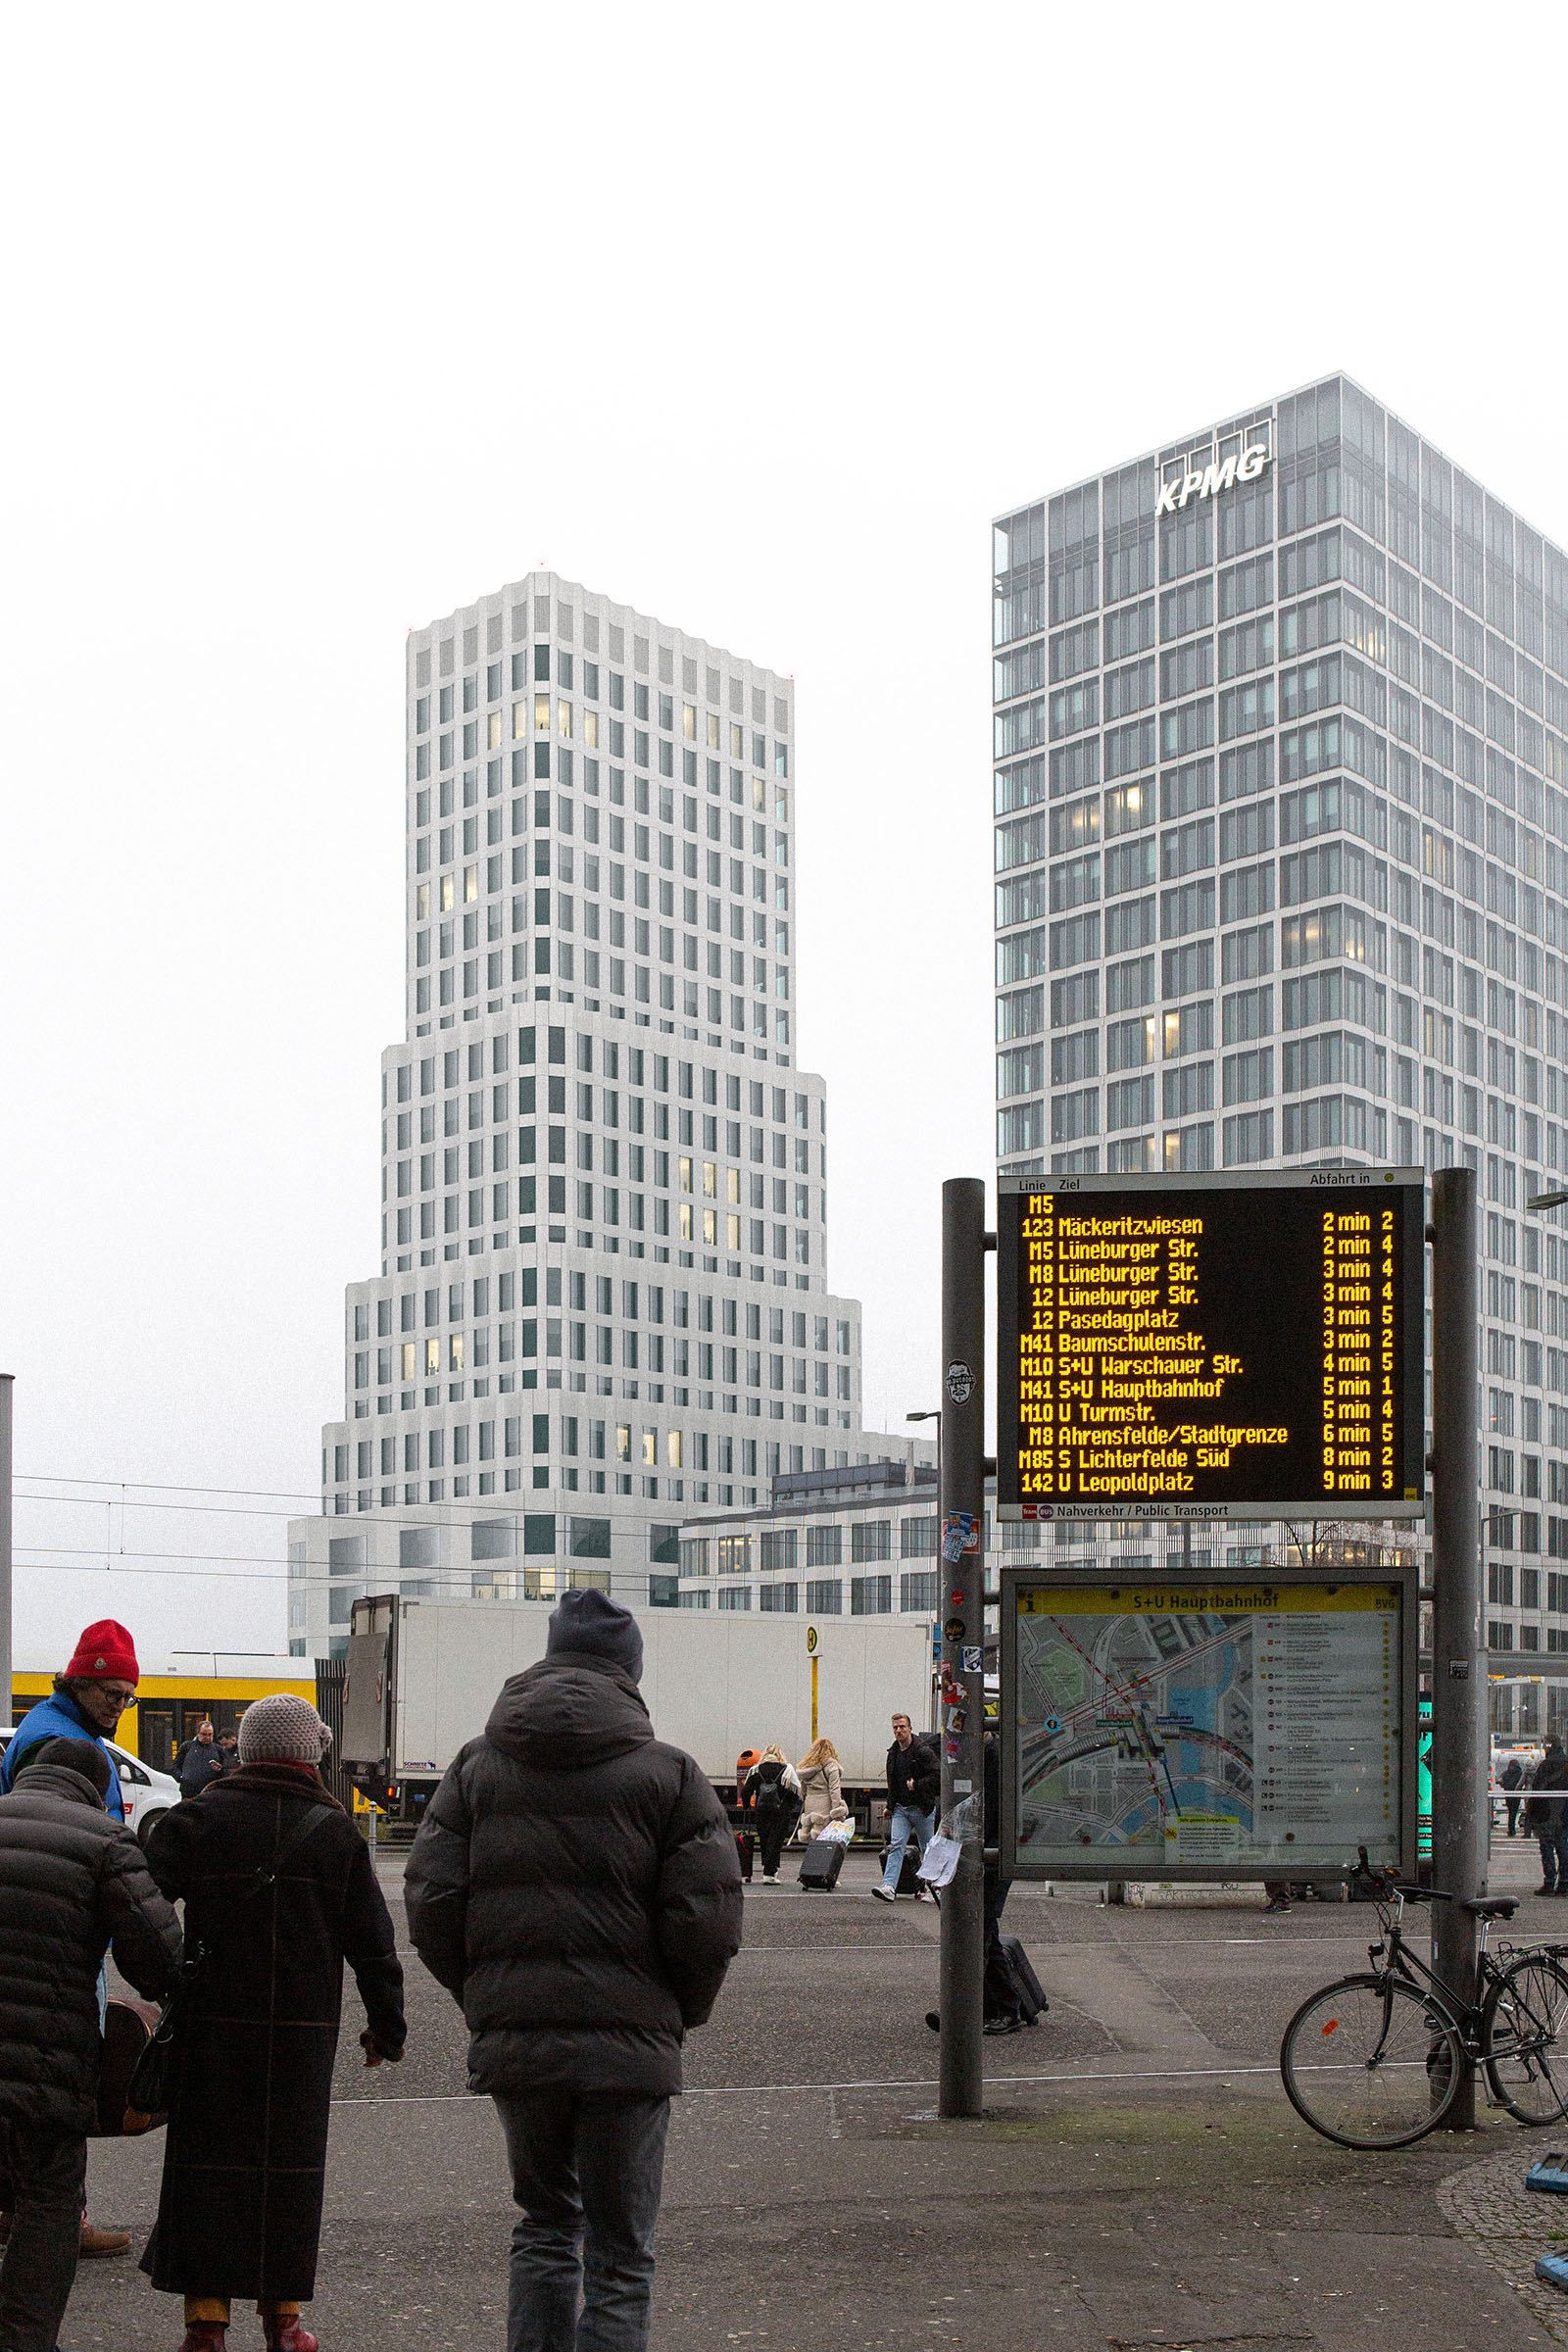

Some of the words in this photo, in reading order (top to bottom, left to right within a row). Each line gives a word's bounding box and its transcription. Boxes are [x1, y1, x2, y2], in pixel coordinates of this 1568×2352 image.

[1154, 443, 1266, 516] KPMG
[1019, 1180, 1046, 1191] Linie
[1059, 1179, 1080, 1190] Ziel
[1310, 1173, 1355, 1185] Abfahrt
[1359, 1173, 1370, 1184] in
[1030, 1196, 1054, 1213] M5
[1022, 1218, 1054, 1237] 123
[1058, 1216, 1202, 1237] Mäckeritzwiesen
[1324, 1212, 1334, 1231] 2
[1339, 1212, 1370, 1231] min
[1382, 1211, 1393, 1230] 2
[1030, 1242, 1054, 1260] M5
[1059, 1241, 1159, 1262] Lüneburger
[1168, 1239, 1198, 1257] Str.
[1324, 1236, 1334, 1254] 2
[1339, 1236, 1370, 1254] min
[1382, 1235, 1393, 1253] 4
[1030, 1264, 1054, 1284] M8
[1058, 1263, 1159, 1286] Lüneburger
[1168, 1262, 1198, 1281] Str.
[1324, 1259, 1334, 1278] 3
[1339, 1259, 1370, 1278] min
[1383, 1258, 1393, 1277] 4
[1033, 1288, 1054, 1306] 12
[1058, 1287, 1159, 1308] Lüneburger
[1168, 1286, 1198, 1303] Str.
[1324, 1283, 1334, 1301] 3
[1339, 1283, 1370, 1301] min
[1382, 1282, 1393, 1300] 4
[1033, 1311, 1054, 1330] 12
[1059, 1309, 1179, 1332] Pasedagplatz
[1324, 1306, 1334, 1325] 3
[1339, 1306, 1370, 1325] min
[1382, 1305, 1393, 1324] 5
[1020, 1334, 1054, 1352] M41
[1058, 1331, 1205, 1352] Baumschulenstr.
[1323, 1330, 1334, 1348] 3
[1339, 1330, 1370, 1348] min
[1382, 1329, 1393, 1348] 2
[1021, 1357, 1054, 1376] M10
[1058, 1357, 1093, 1376] S+U
[1102, 1355, 1203, 1375] Warschauer
[1213, 1355, 1243, 1373] Str.
[1324, 1353, 1334, 1372] 4
[1339, 1353, 1370, 1371] min
[1382, 1352, 1393, 1371] 5
[1020, 1381, 1054, 1398] M41
[1059, 1380, 1093, 1398] S+U
[1102, 1378, 1225, 1401] Hauptbahnhof
[1324, 1377, 1334, 1396] 5
[1339, 1377, 1370, 1396] min
[1382, 1376, 1393, 1395] 1
[1021, 1403, 1054, 1422] M10
[1058, 1403, 1070, 1422] U
[1079, 1402, 1155, 1422] Turmstr.
[1323, 1400, 1334, 1419] 5
[1339, 1400, 1370, 1419] min
[1382, 1399, 1393, 1418] 4
[1030, 1427, 1054, 1446] M8
[1058, 1425, 1288, 1447] Ahrensfelde/Stadtgrenze
[1324, 1424, 1334, 1442] 6
[1339, 1424, 1370, 1442] min
[1382, 1423, 1393, 1442] 5
[1019, 1450, 1054, 1469] M85
[1058, 1449, 1070, 1468] S
[1079, 1448, 1188, 1468] Lichterfelde
[1197, 1448, 1229, 1467] Süd
[1323, 1447, 1335, 1466] 8
[1339, 1447, 1370, 1465] min
[1382, 1446, 1393, 1465] 2
[1022, 1473, 1053, 1492] 142
[1058, 1473, 1070, 1492] U
[1079, 1472, 1194, 1494] Leopoldplatz
[1324, 1470, 1334, 1490] 9
[1339, 1470, 1370, 1489] min
[1382, 1470, 1393, 1489] 3
[1057, 1505, 1124, 1516] Nahverkehr
[1127, 1505, 1132, 1516] /
[1135, 1505, 1170, 1516] Public
[1174, 1504, 1229, 1518] Transport
[1134, 1595, 1164, 1608] S+U
[1170, 1592, 1279, 1610] Hauptbahnhof
[1375, 1598, 1396, 1610] BVG
